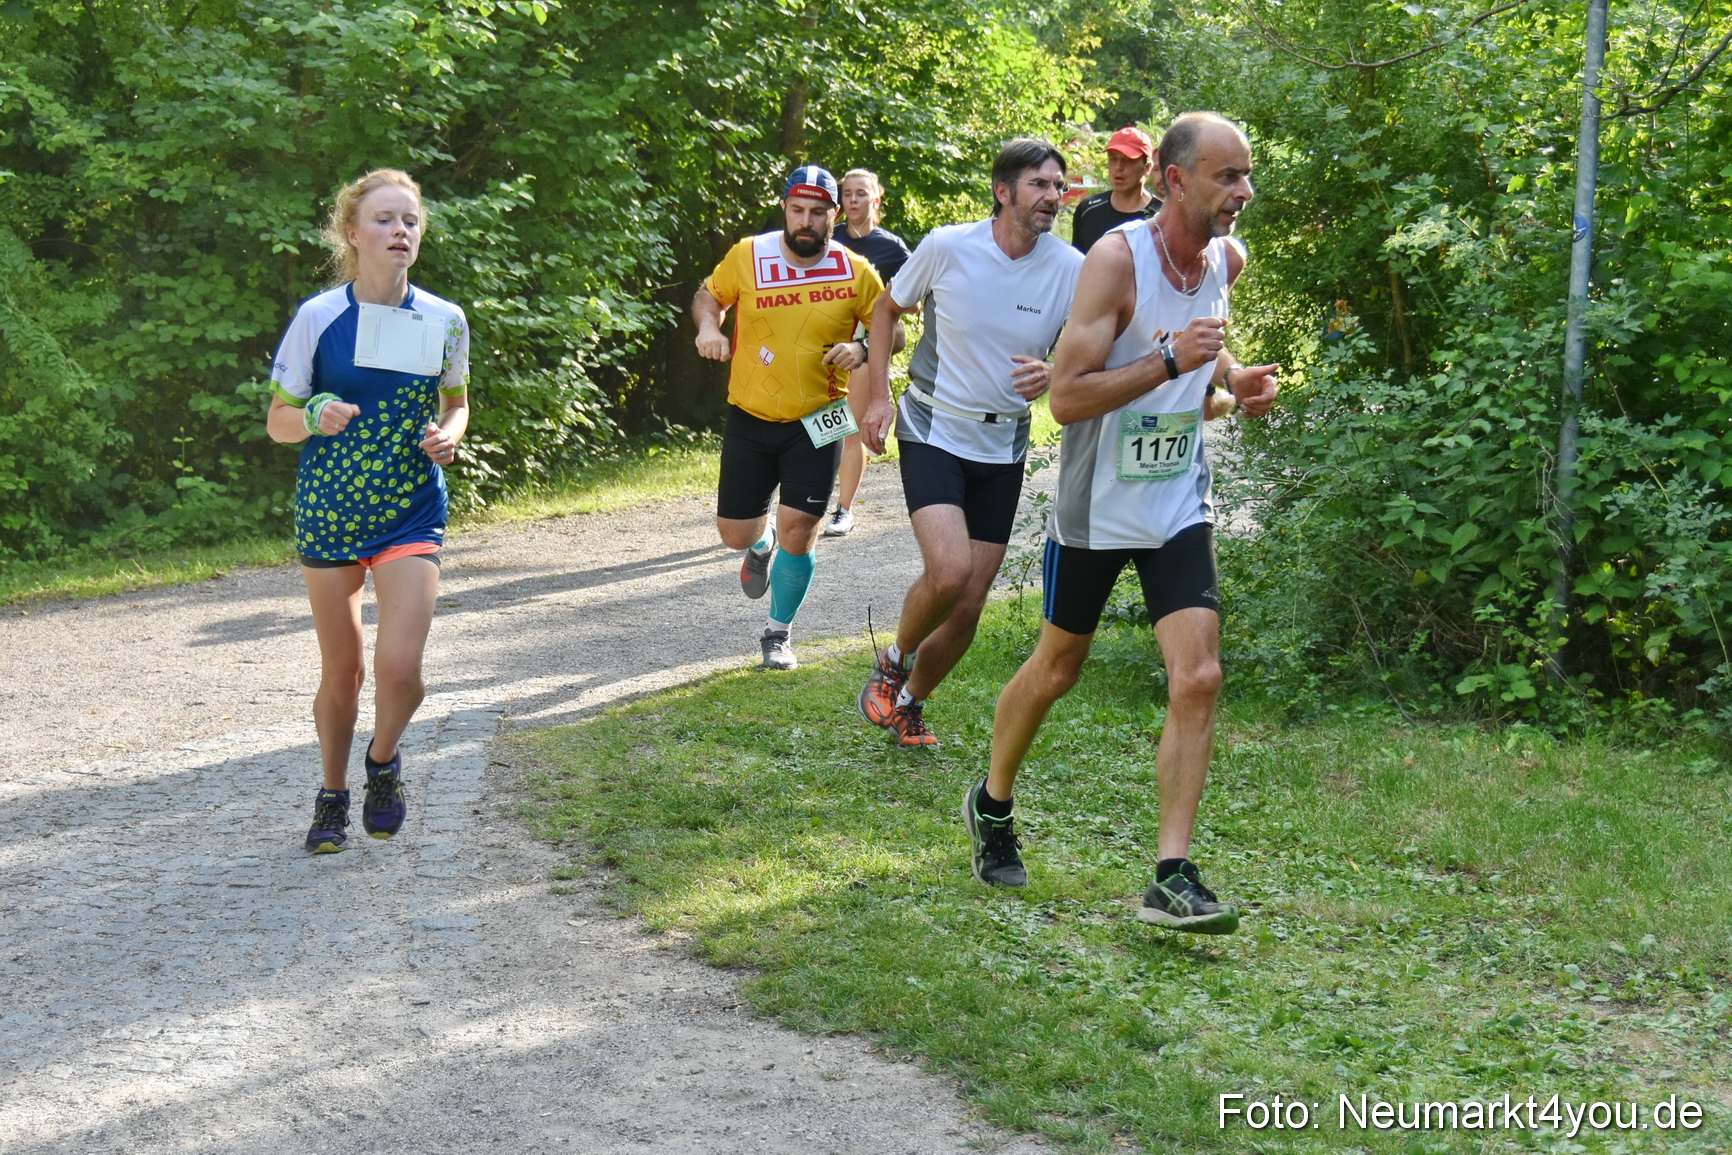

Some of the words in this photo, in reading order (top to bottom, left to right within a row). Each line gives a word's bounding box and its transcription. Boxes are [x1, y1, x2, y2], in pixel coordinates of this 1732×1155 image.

[756, 292, 803, 310] MAX
[808, 286, 858, 304] BÖGL
[1016, 304, 1042, 314] Markus
[812, 407, 848, 433] 1661
[1131, 435, 1188, 461] 1170
